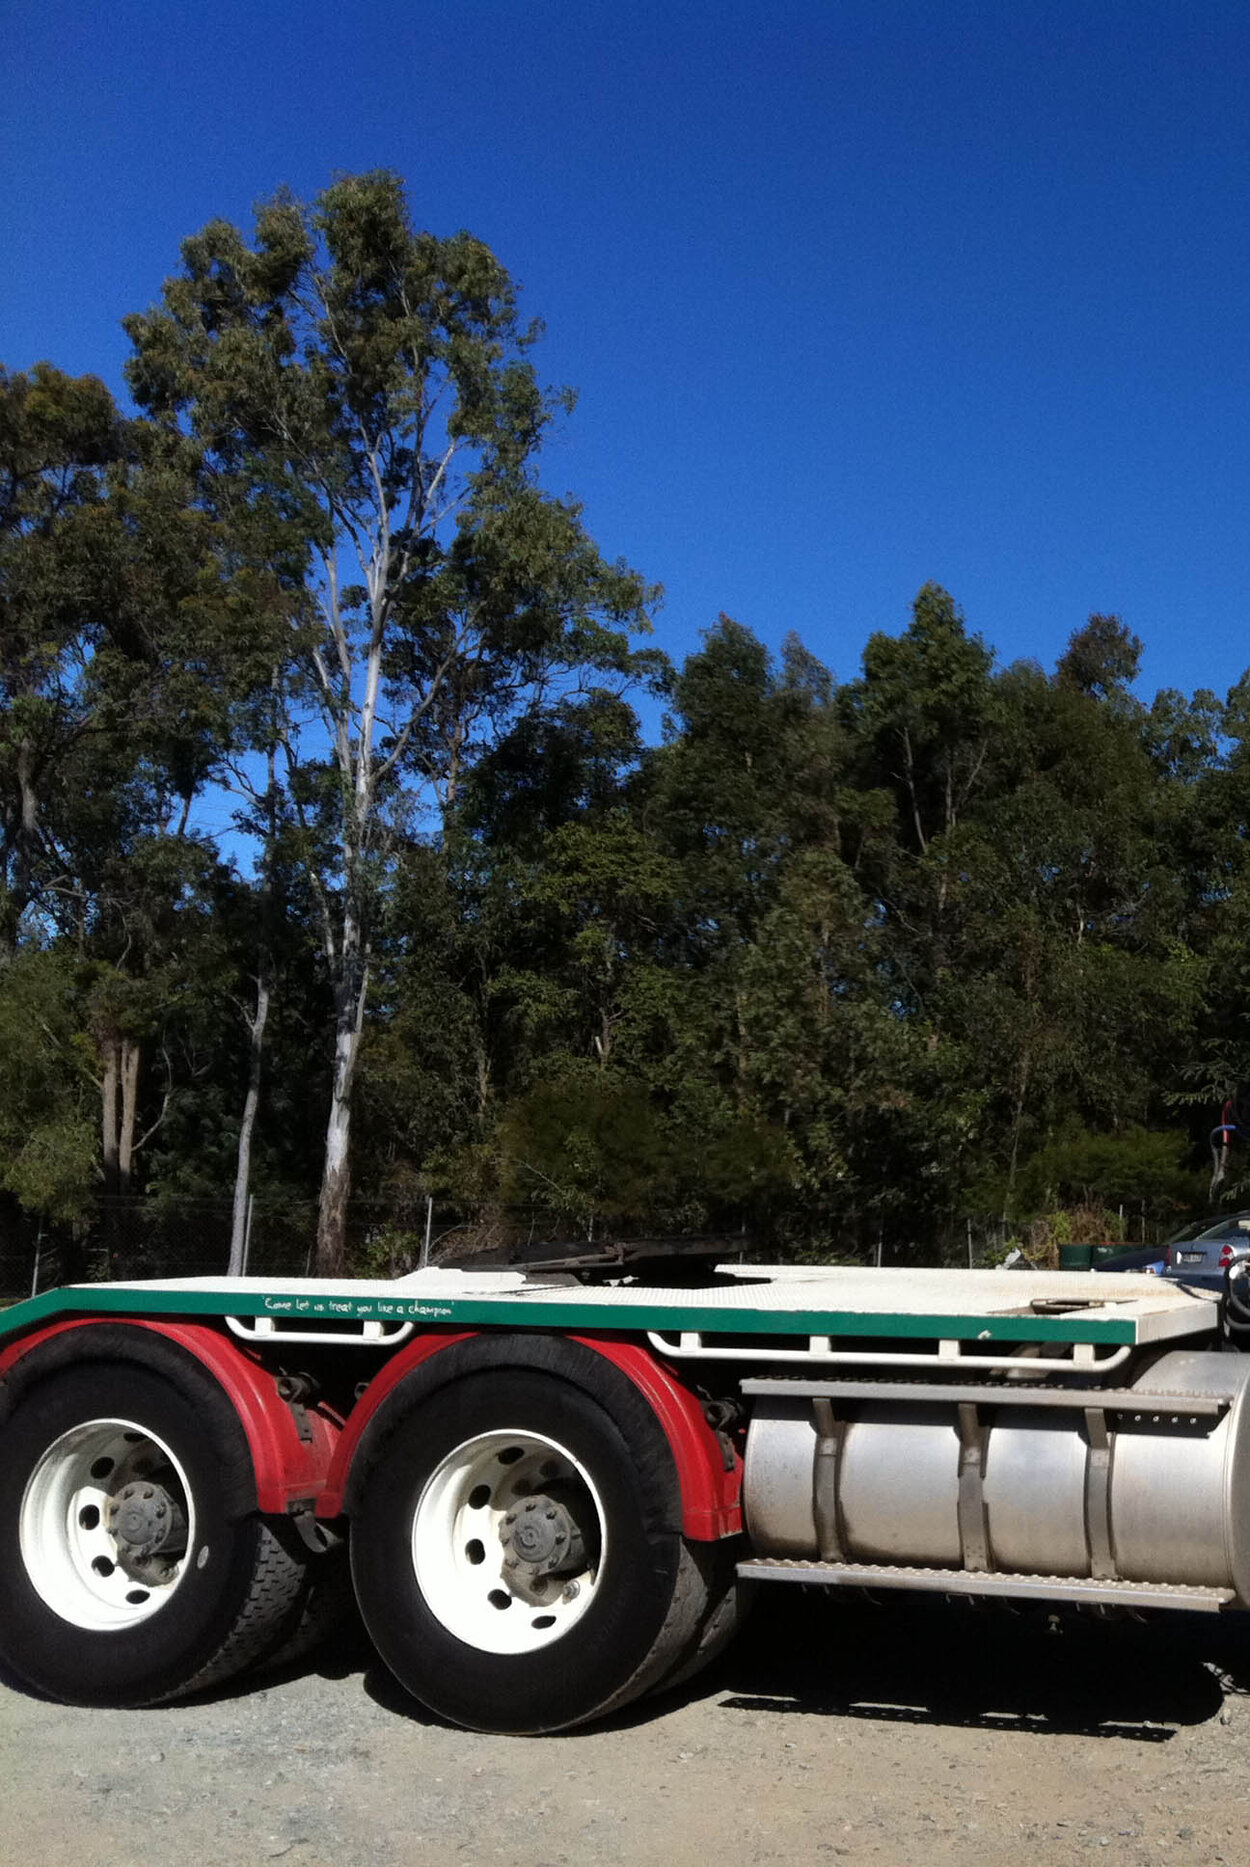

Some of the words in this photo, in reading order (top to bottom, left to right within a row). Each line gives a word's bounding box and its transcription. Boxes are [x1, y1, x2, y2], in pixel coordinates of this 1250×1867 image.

[328, 1301, 352, 1313] treat
[356, 1305, 372, 1317] you
[377, 1301, 394, 1314] like
[396, 1305, 405, 1315] a
